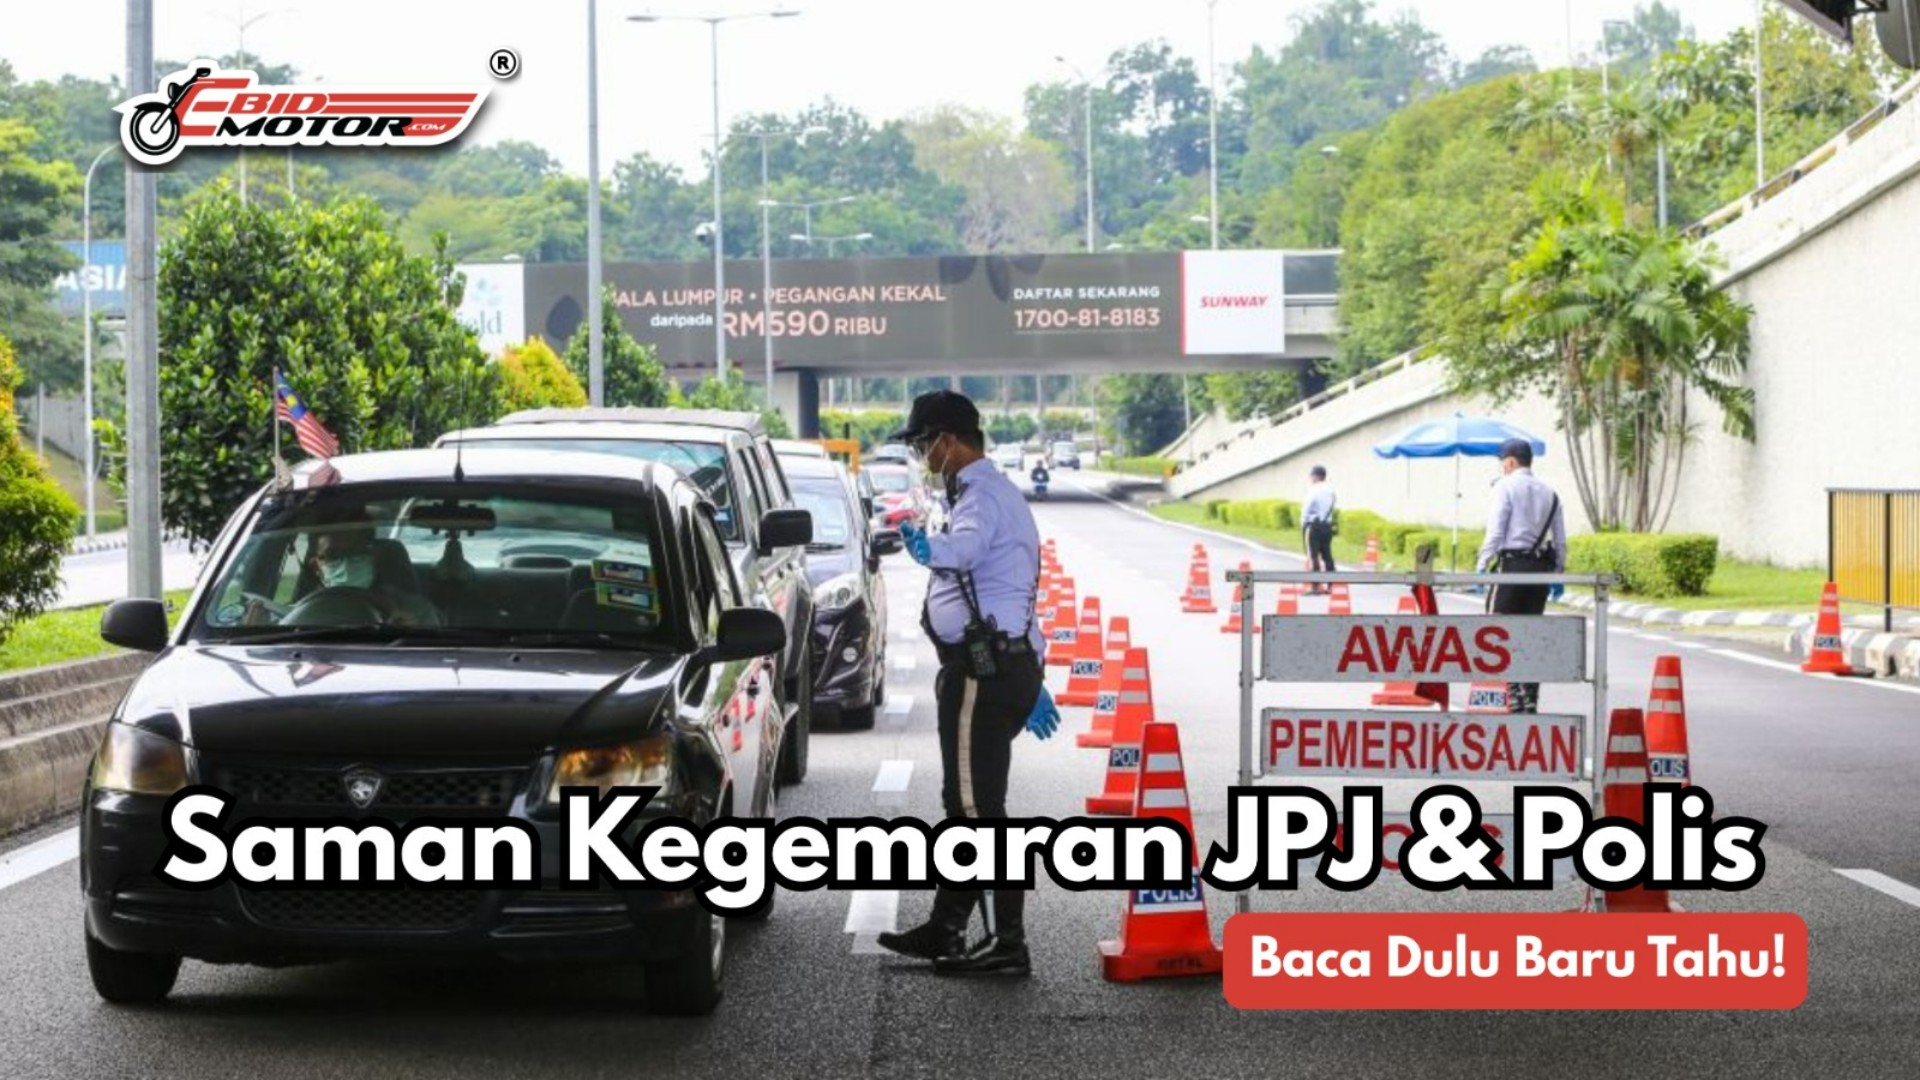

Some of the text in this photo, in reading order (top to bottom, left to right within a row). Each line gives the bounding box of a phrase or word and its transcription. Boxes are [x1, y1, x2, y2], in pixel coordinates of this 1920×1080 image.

[763, 285, 875, 303] PEGANGAN
[881, 285, 947, 302] KEKAL
[1013, 286, 1160, 300] DAFTAR SEKARANG
[1199, 295, 1268, 308] SUNWAY
[650, 310, 887, 337] daripada RM590 RIBU
[1014, 308, 1161, 328] 1700-81-8183
[1337, 624, 1512, 673] AWAS
[1470, 690, 1506, 706] POLIS
[1268, 718, 1577, 774] PEMERIKSAAN
